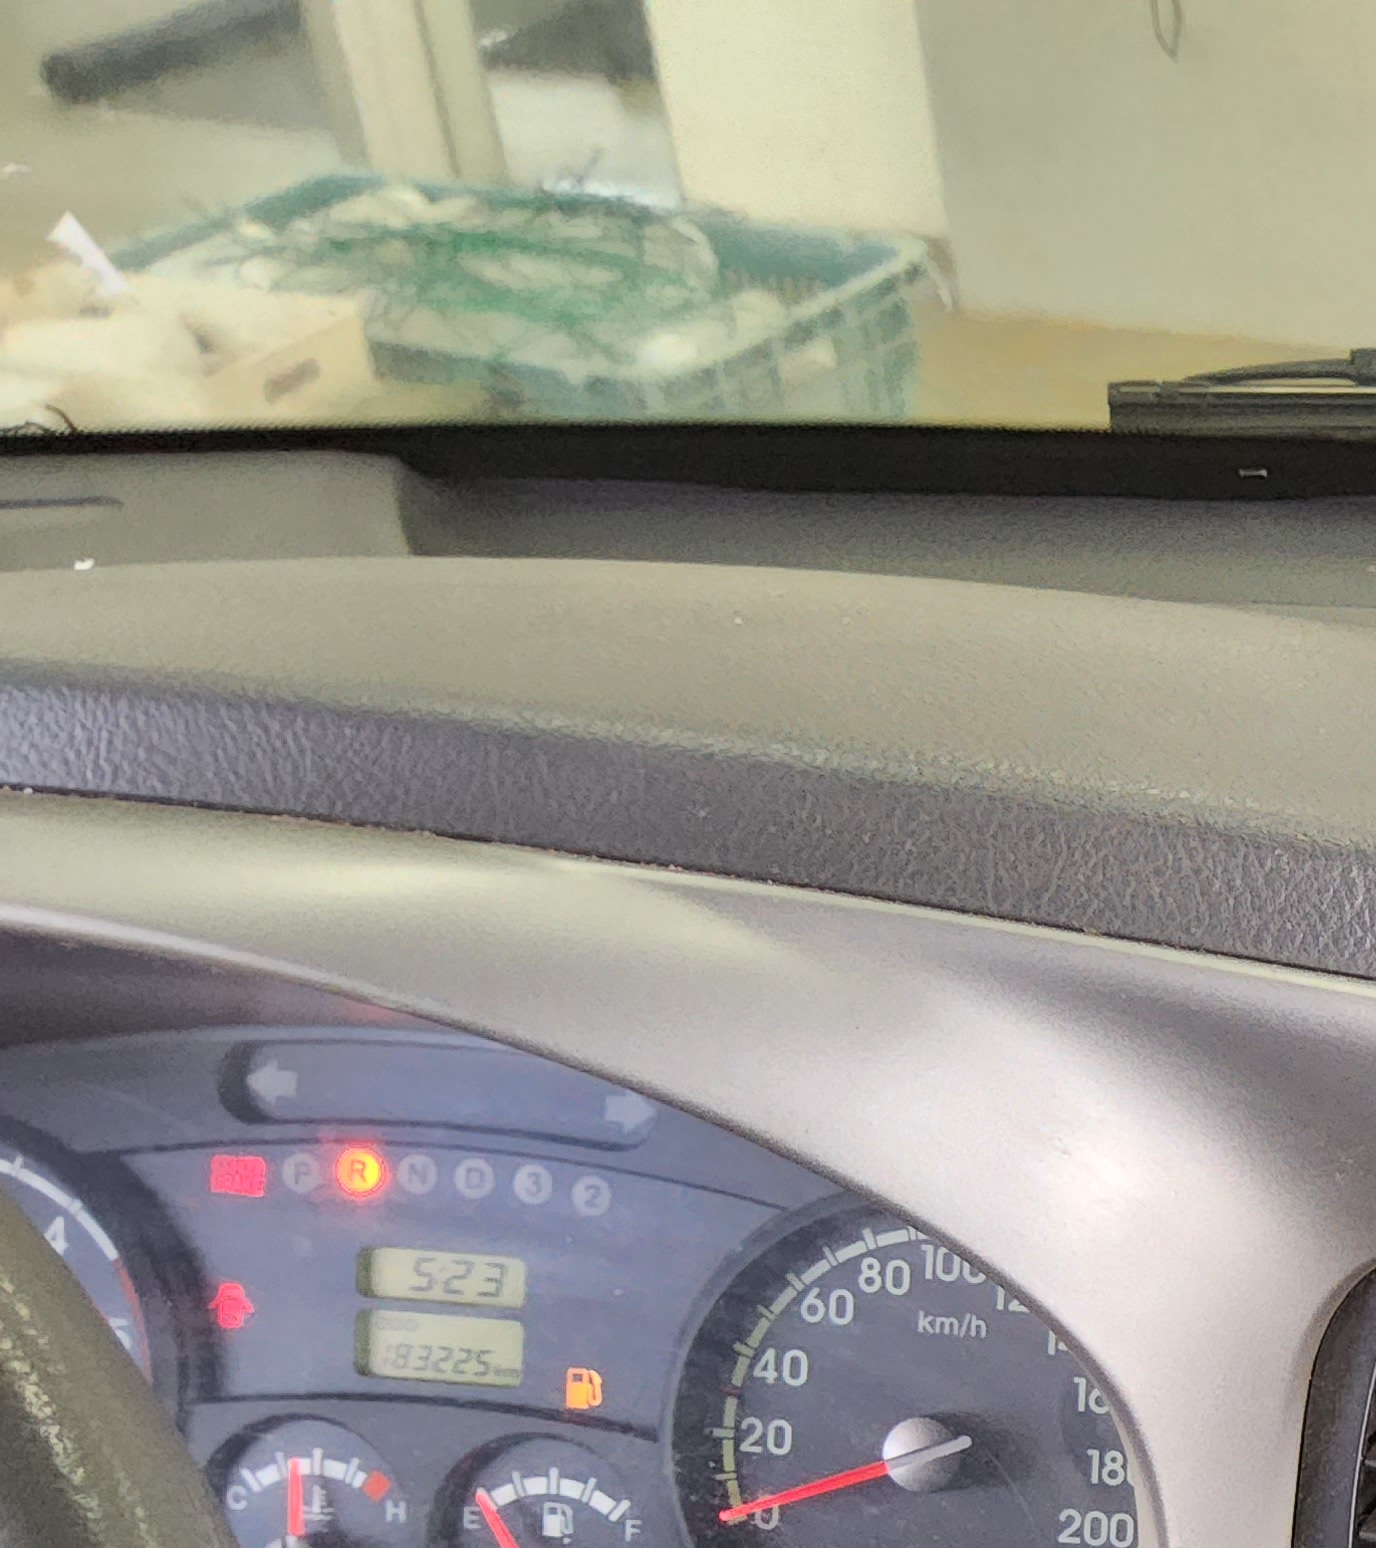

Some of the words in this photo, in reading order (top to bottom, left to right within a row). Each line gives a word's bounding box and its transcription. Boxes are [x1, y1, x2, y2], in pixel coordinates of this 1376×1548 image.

[43, 1216, 68, 1256] 4
[858, 1257, 911, 1295] 80
[800, 1288, 854, 1325] 60
[917, 1310, 988, 1339] km/h
[754, 1349, 808, 1386] 40
[740, 1417, 793, 1456] 20
[1087, 1448, 1130, 1486] 18
[227, 1486, 248, 1512] C
[386, 1500, 407, 1524] H
[463, 1506, 481, 1530] E
[624, 1518, 642, 1543] F
[1058, 1508, 1135, 1548] 200
